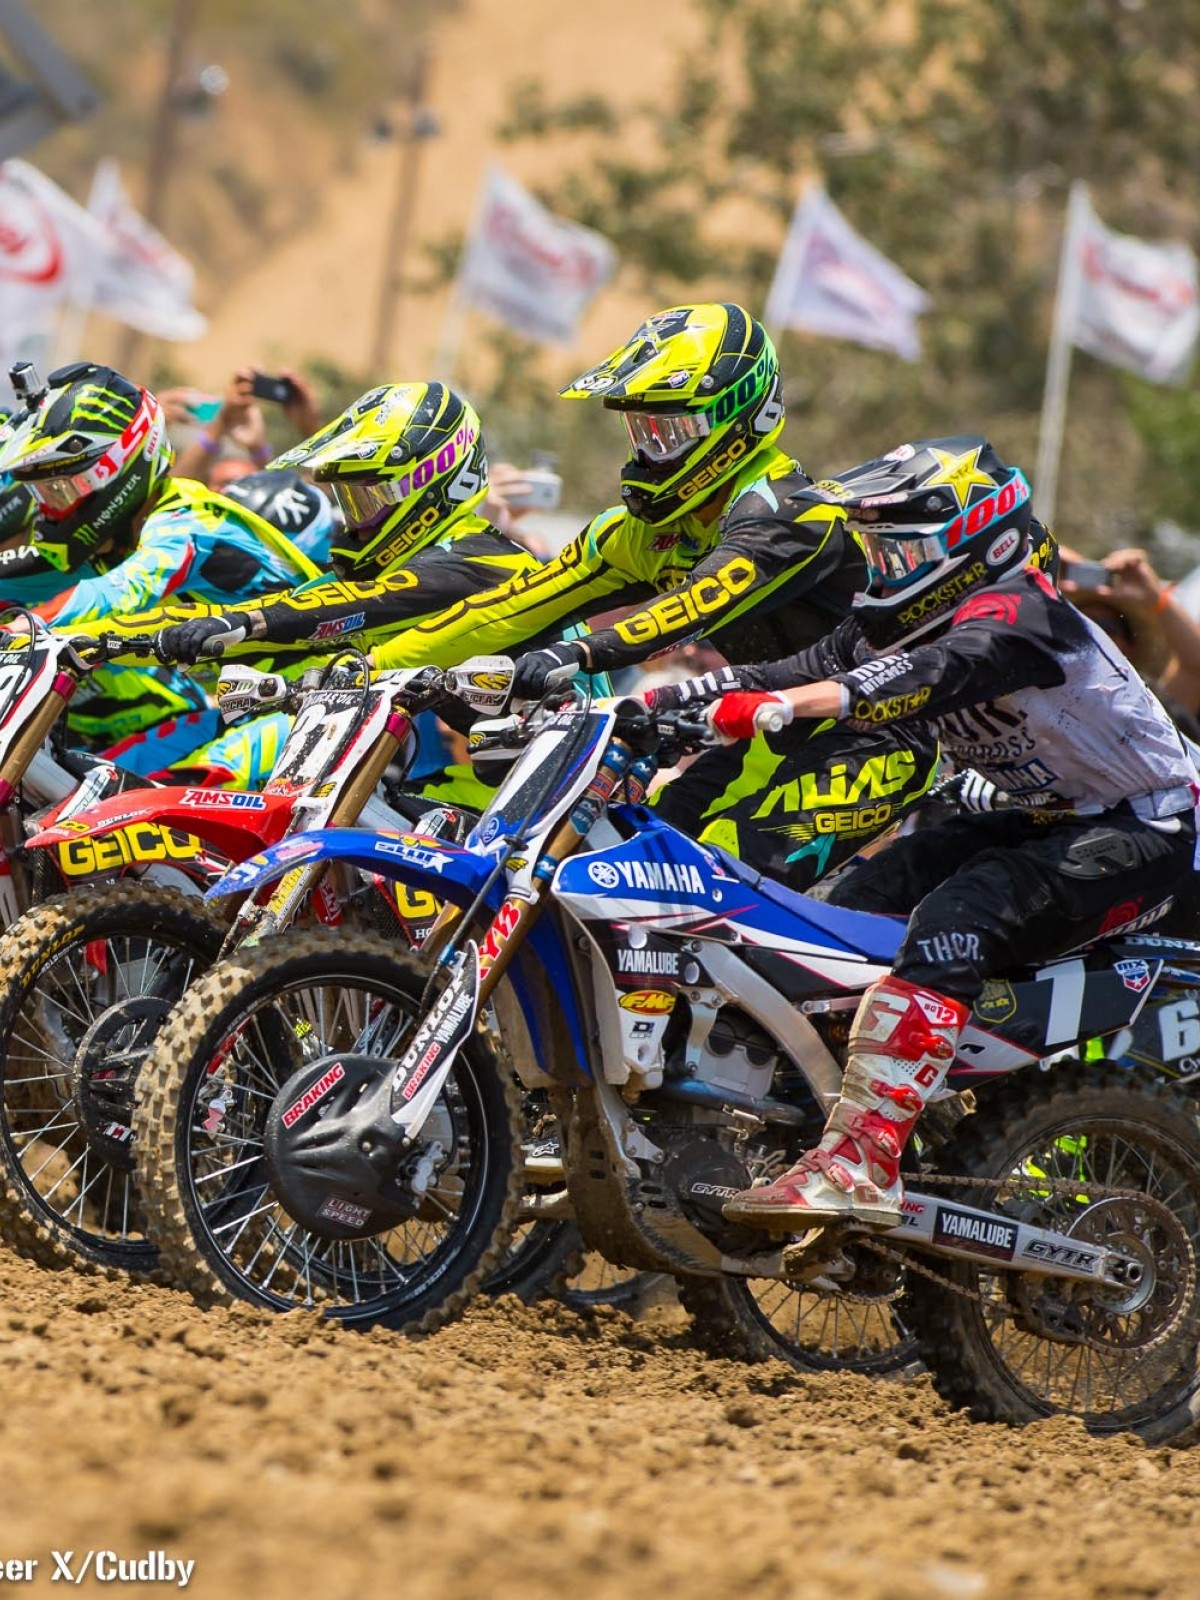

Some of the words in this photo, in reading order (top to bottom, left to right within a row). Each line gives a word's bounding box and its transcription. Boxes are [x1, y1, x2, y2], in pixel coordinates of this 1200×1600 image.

[677, 439, 746, 501] GEICO
[375, 505, 440, 567] GEICO
[992, 535, 1016, 559] BELL
[286, 570, 419, 611] GEICO
[614, 557, 756, 645] GEICO
[180, 789, 267, 811] AMSOIL
[815, 804, 892, 834] GEICO
[615, 861, 705, 895] YAMAHA
[617, 949, 679, 975] YAMALUBE
[434, 990, 474, 1043] YAMALUBE
[402, 1042, 441, 1100] BRAKING
[282, 1062, 345, 1128] BRAKING
[321, 1208, 364, 1227] SPEED
[326, 1198, 372, 1218] LIGHT
[942, 1212, 1013, 1249] YAMALUBE
[1026, 1239, 1099, 1268] GYTR
